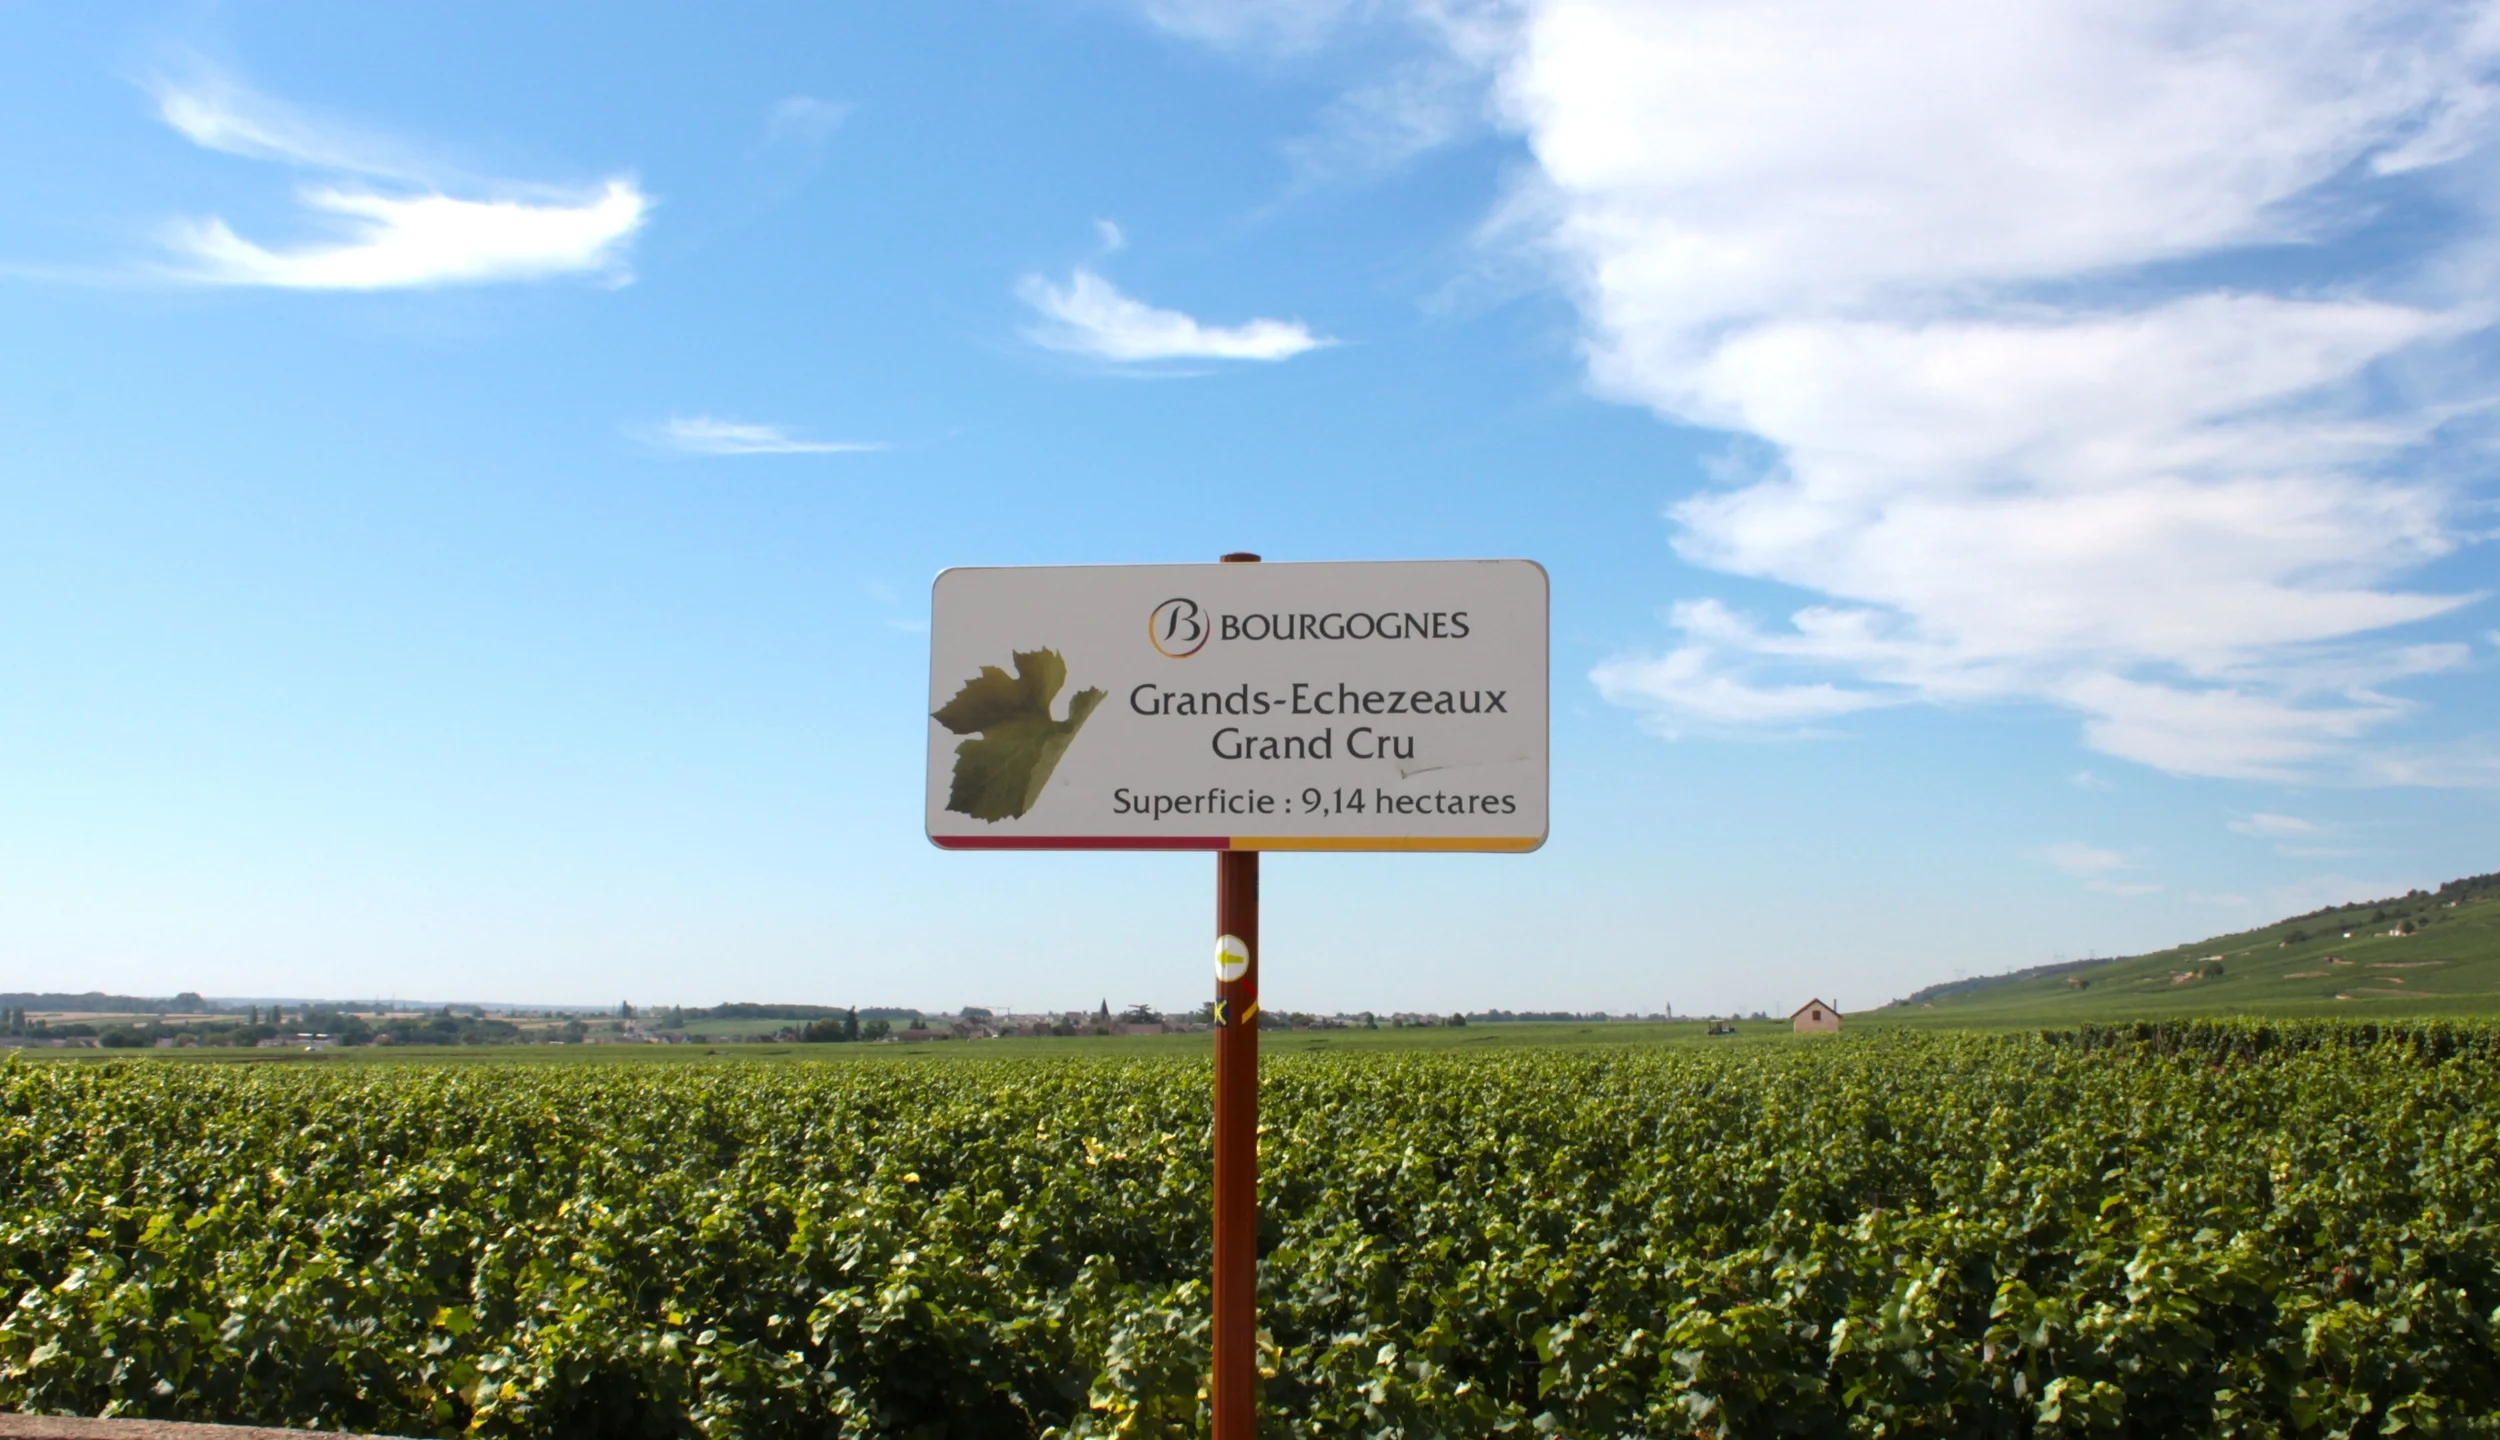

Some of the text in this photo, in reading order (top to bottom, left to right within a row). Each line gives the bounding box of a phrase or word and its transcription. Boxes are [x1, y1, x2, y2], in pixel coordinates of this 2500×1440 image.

[1152, 597, 1470, 642] B BOURGOGNES
[1129, 682, 1508, 716] Grands-Echezeaux
[1211, 726, 1415, 761] Grand Cru
[1113, 787, 1275, 821] Superficie
[1301, 787, 1366, 818] 9,14
[1375, 787, 1517, 815] hectares
